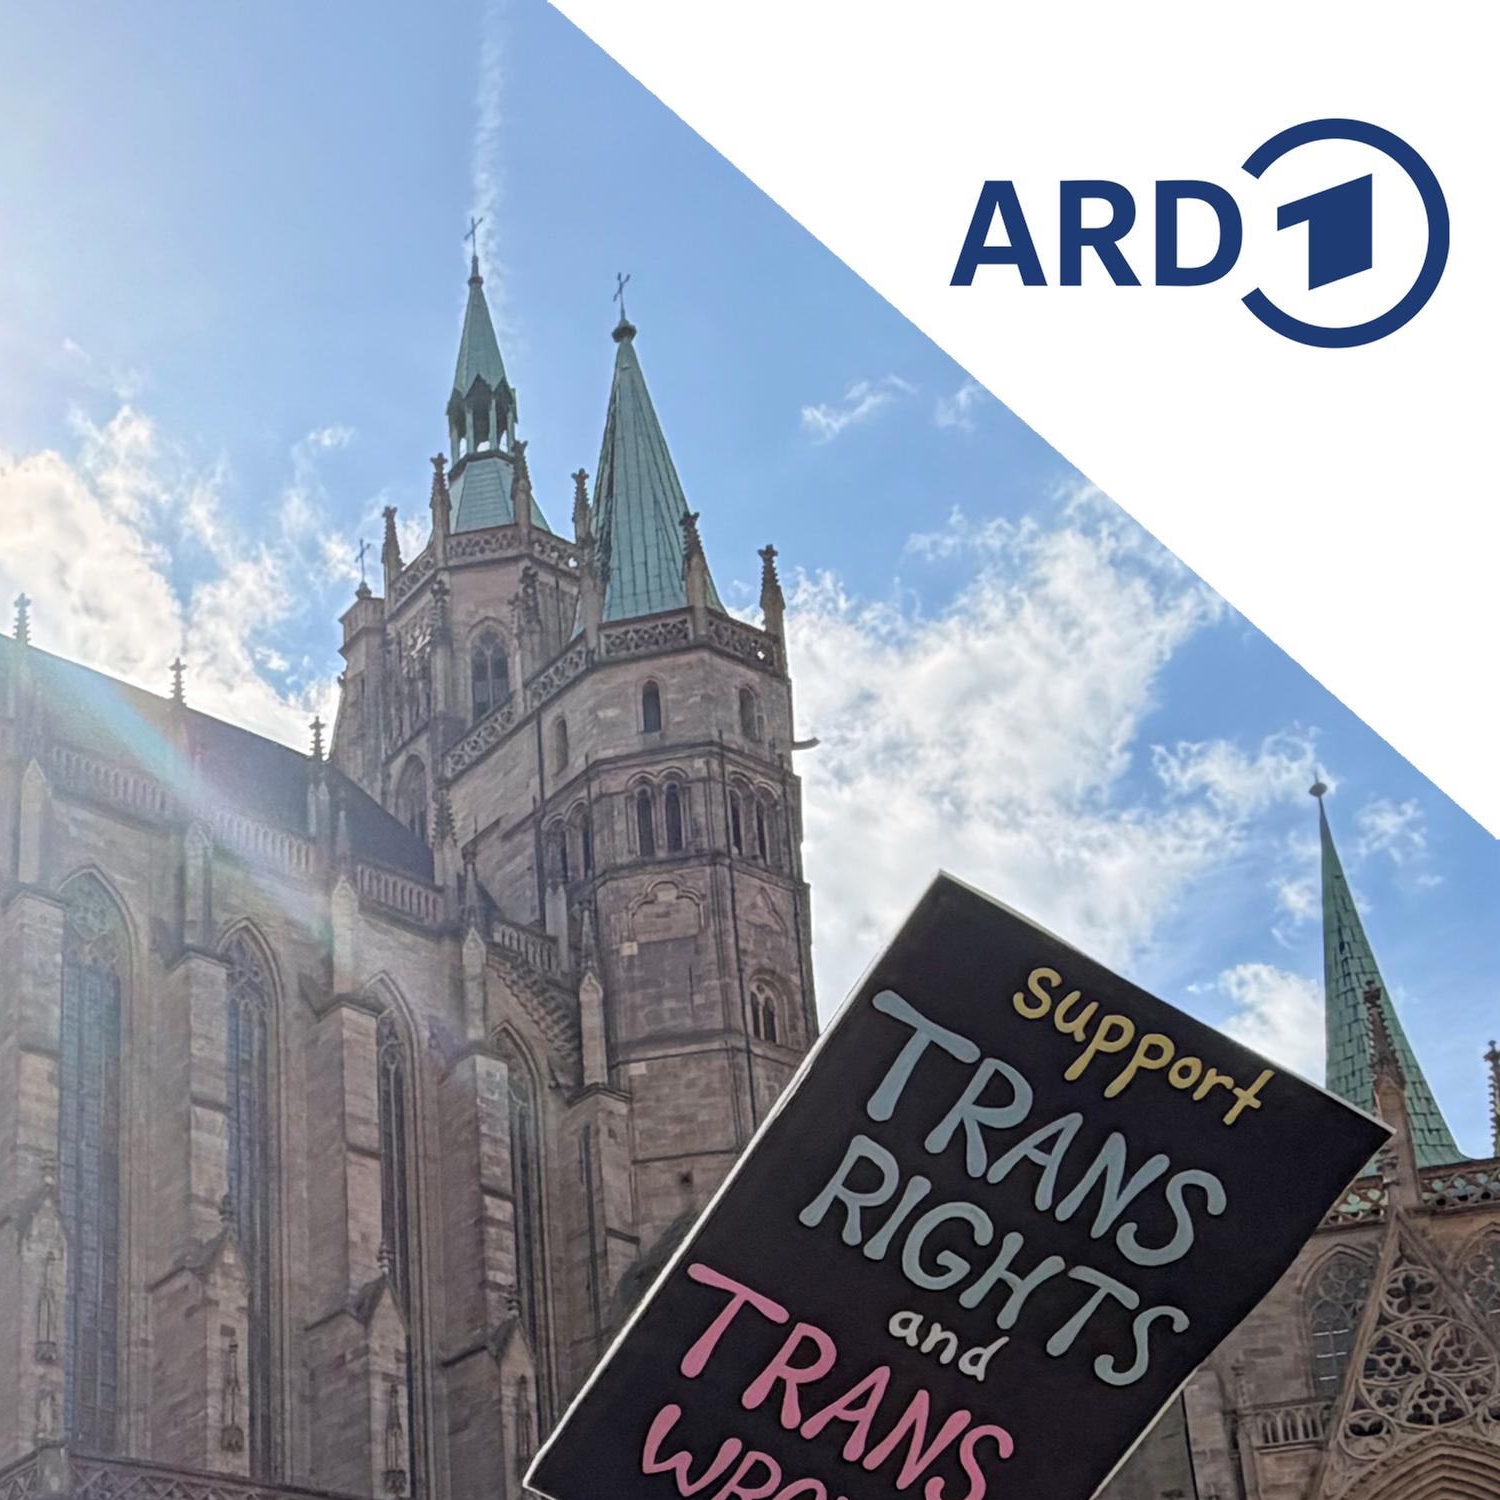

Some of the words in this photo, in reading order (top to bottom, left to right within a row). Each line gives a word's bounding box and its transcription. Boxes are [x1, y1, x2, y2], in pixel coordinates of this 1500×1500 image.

[866, 989, 1227, 1266] TRANS
[1012, 967, 1275, 1125] support
[799, 1134, 1190, 1386] RIGHTS
[888, 1310, 1009, 1381] and
